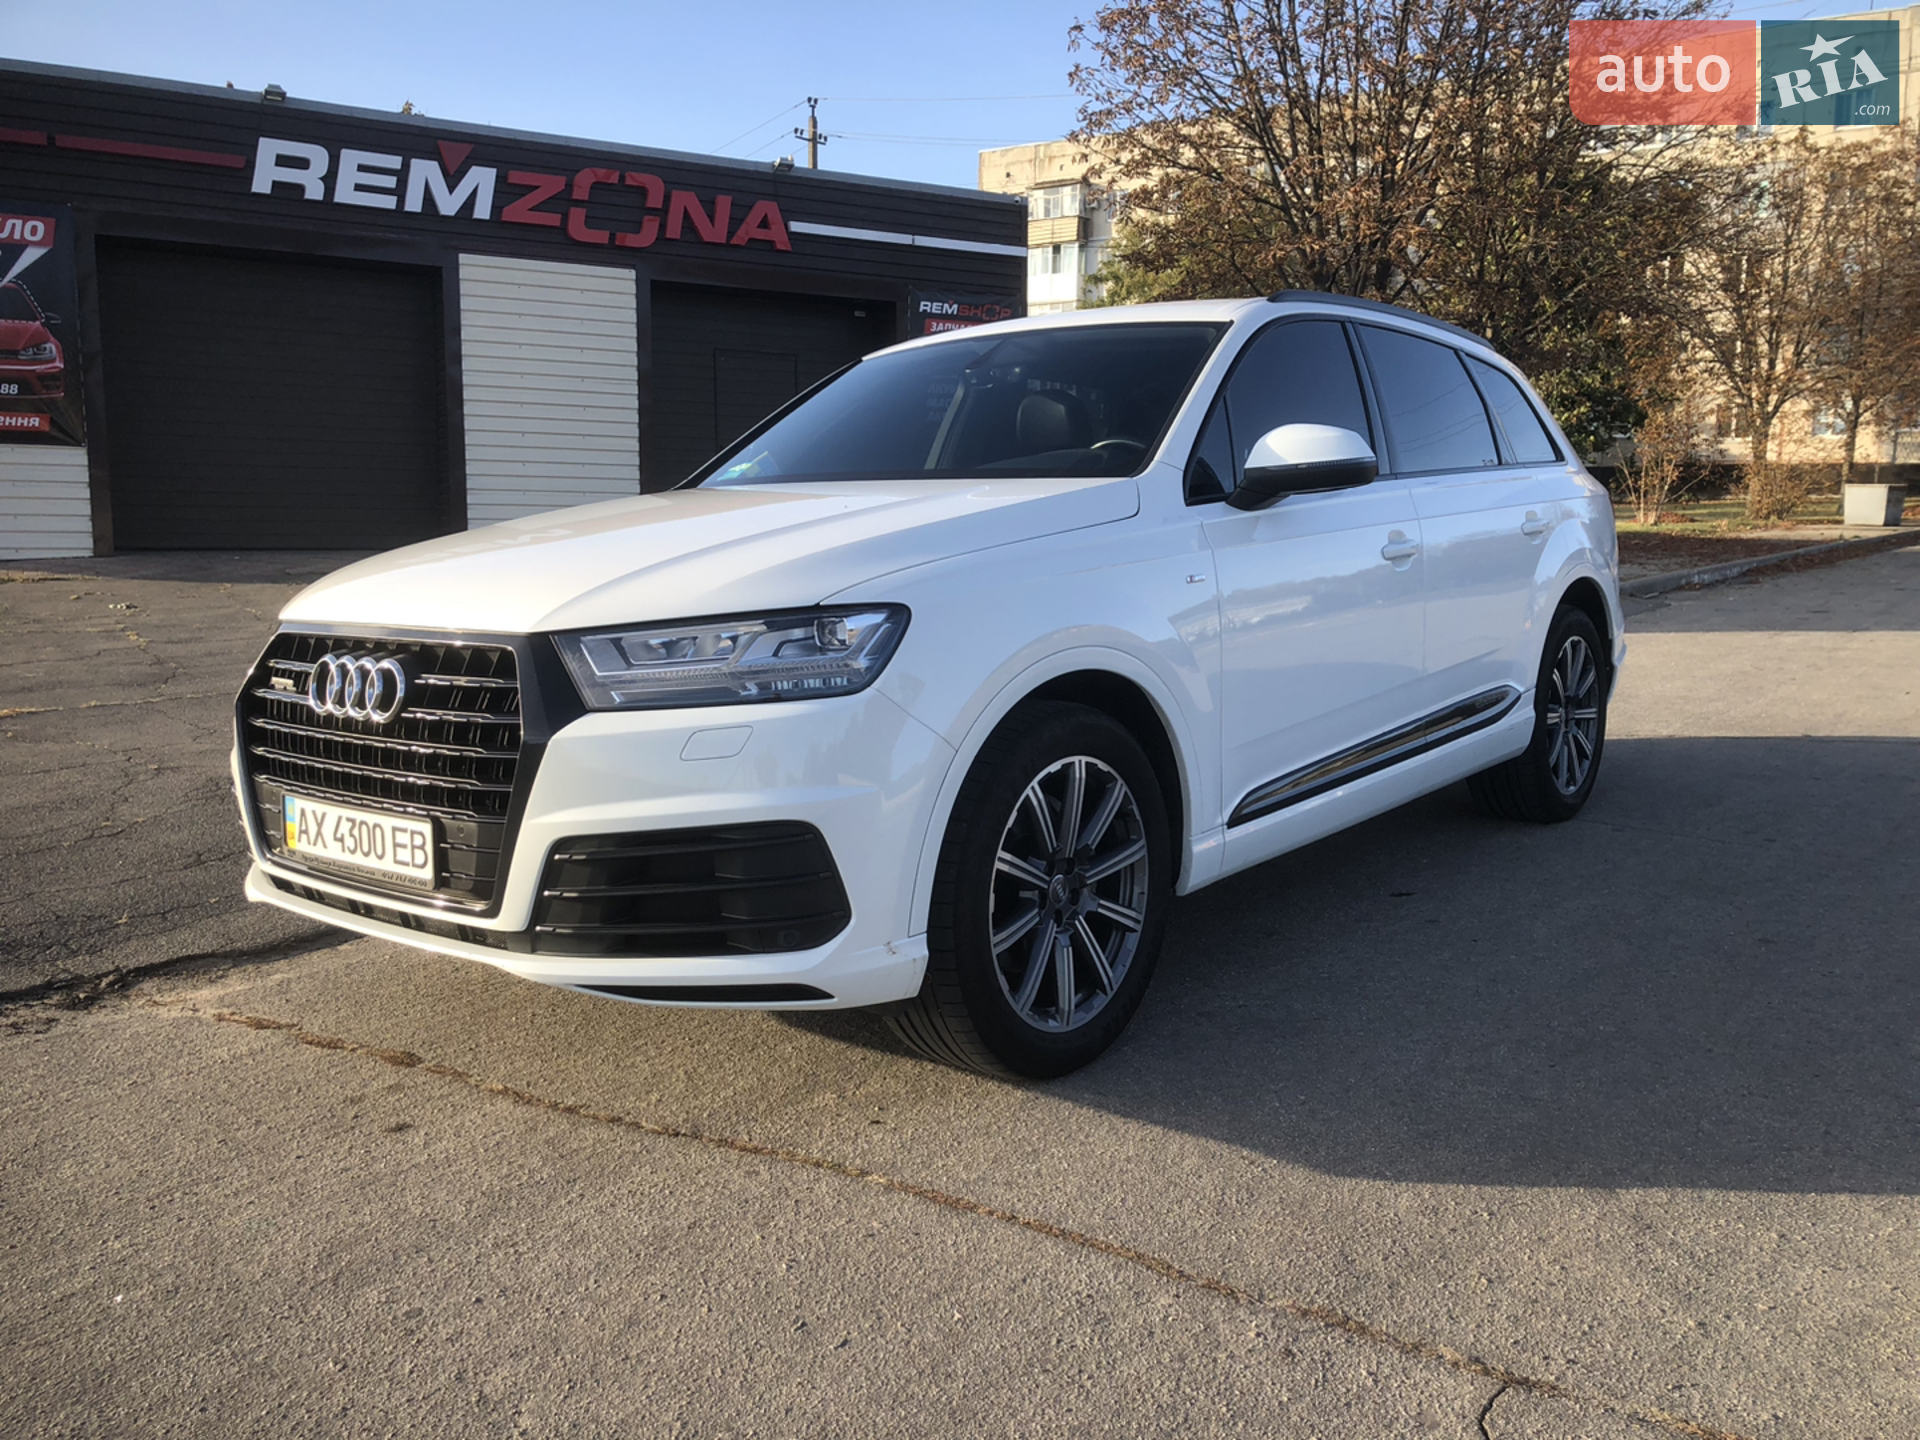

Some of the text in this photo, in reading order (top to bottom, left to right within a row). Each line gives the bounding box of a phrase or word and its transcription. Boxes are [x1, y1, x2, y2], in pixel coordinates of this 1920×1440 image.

[251, 136, 792, 252] REMZONA
[0, 218, 46, 242] ЛО
[918, 300, 1013, 321] REMSHOP
[297, 807, 328, 850] AX
[332, 815, 386, 861] 4300
[391, 825, 429, 870] EB
